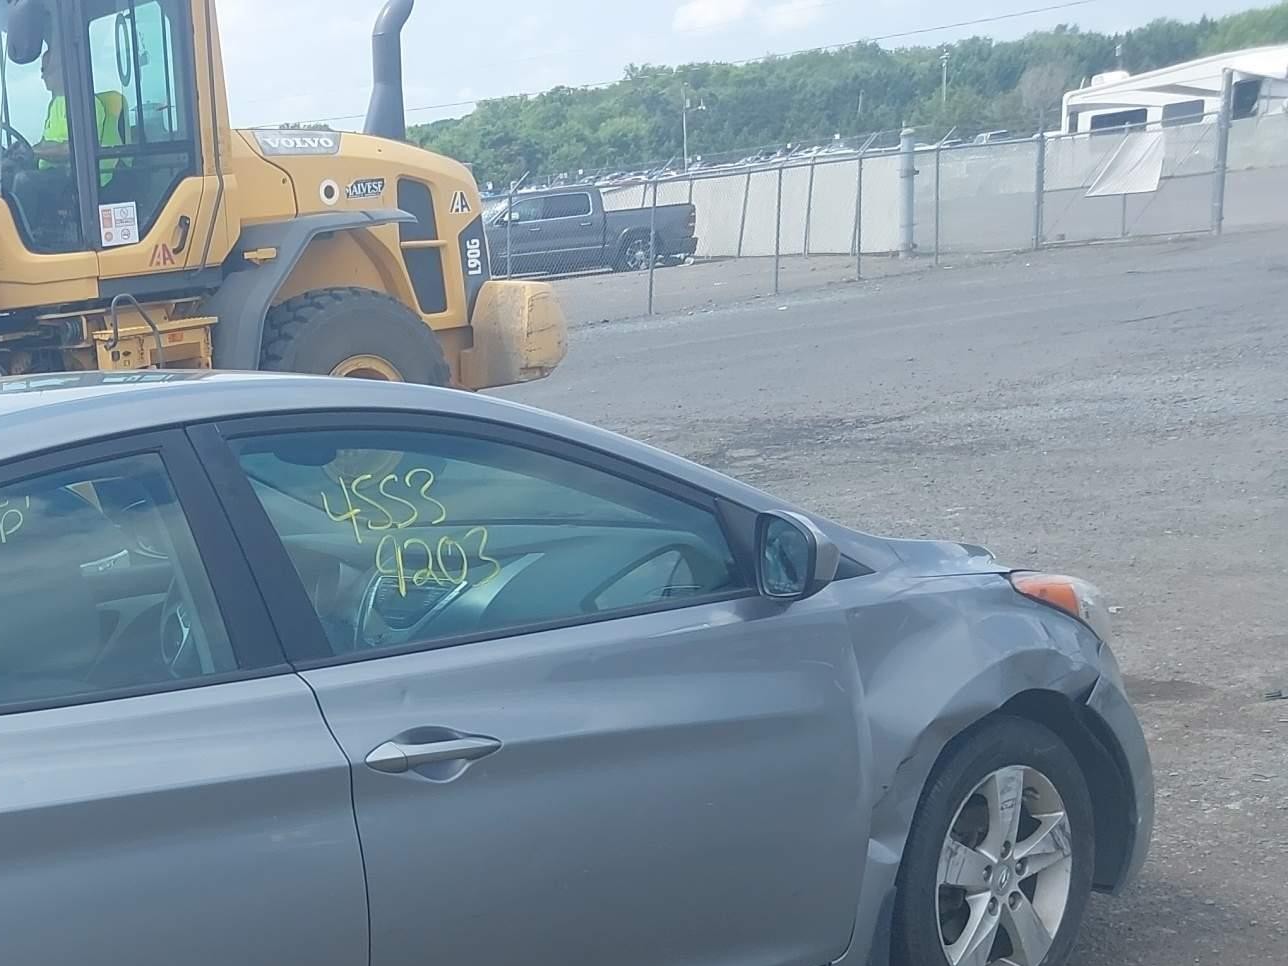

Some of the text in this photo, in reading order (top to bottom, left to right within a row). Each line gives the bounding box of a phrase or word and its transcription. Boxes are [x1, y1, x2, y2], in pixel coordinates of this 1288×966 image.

[264, 136, 334, 149] VOLVO
[466, 238, 482, 276] L90G
[320, 467, 447, 545] 4553
[375, 525, 501, 598] 9203
